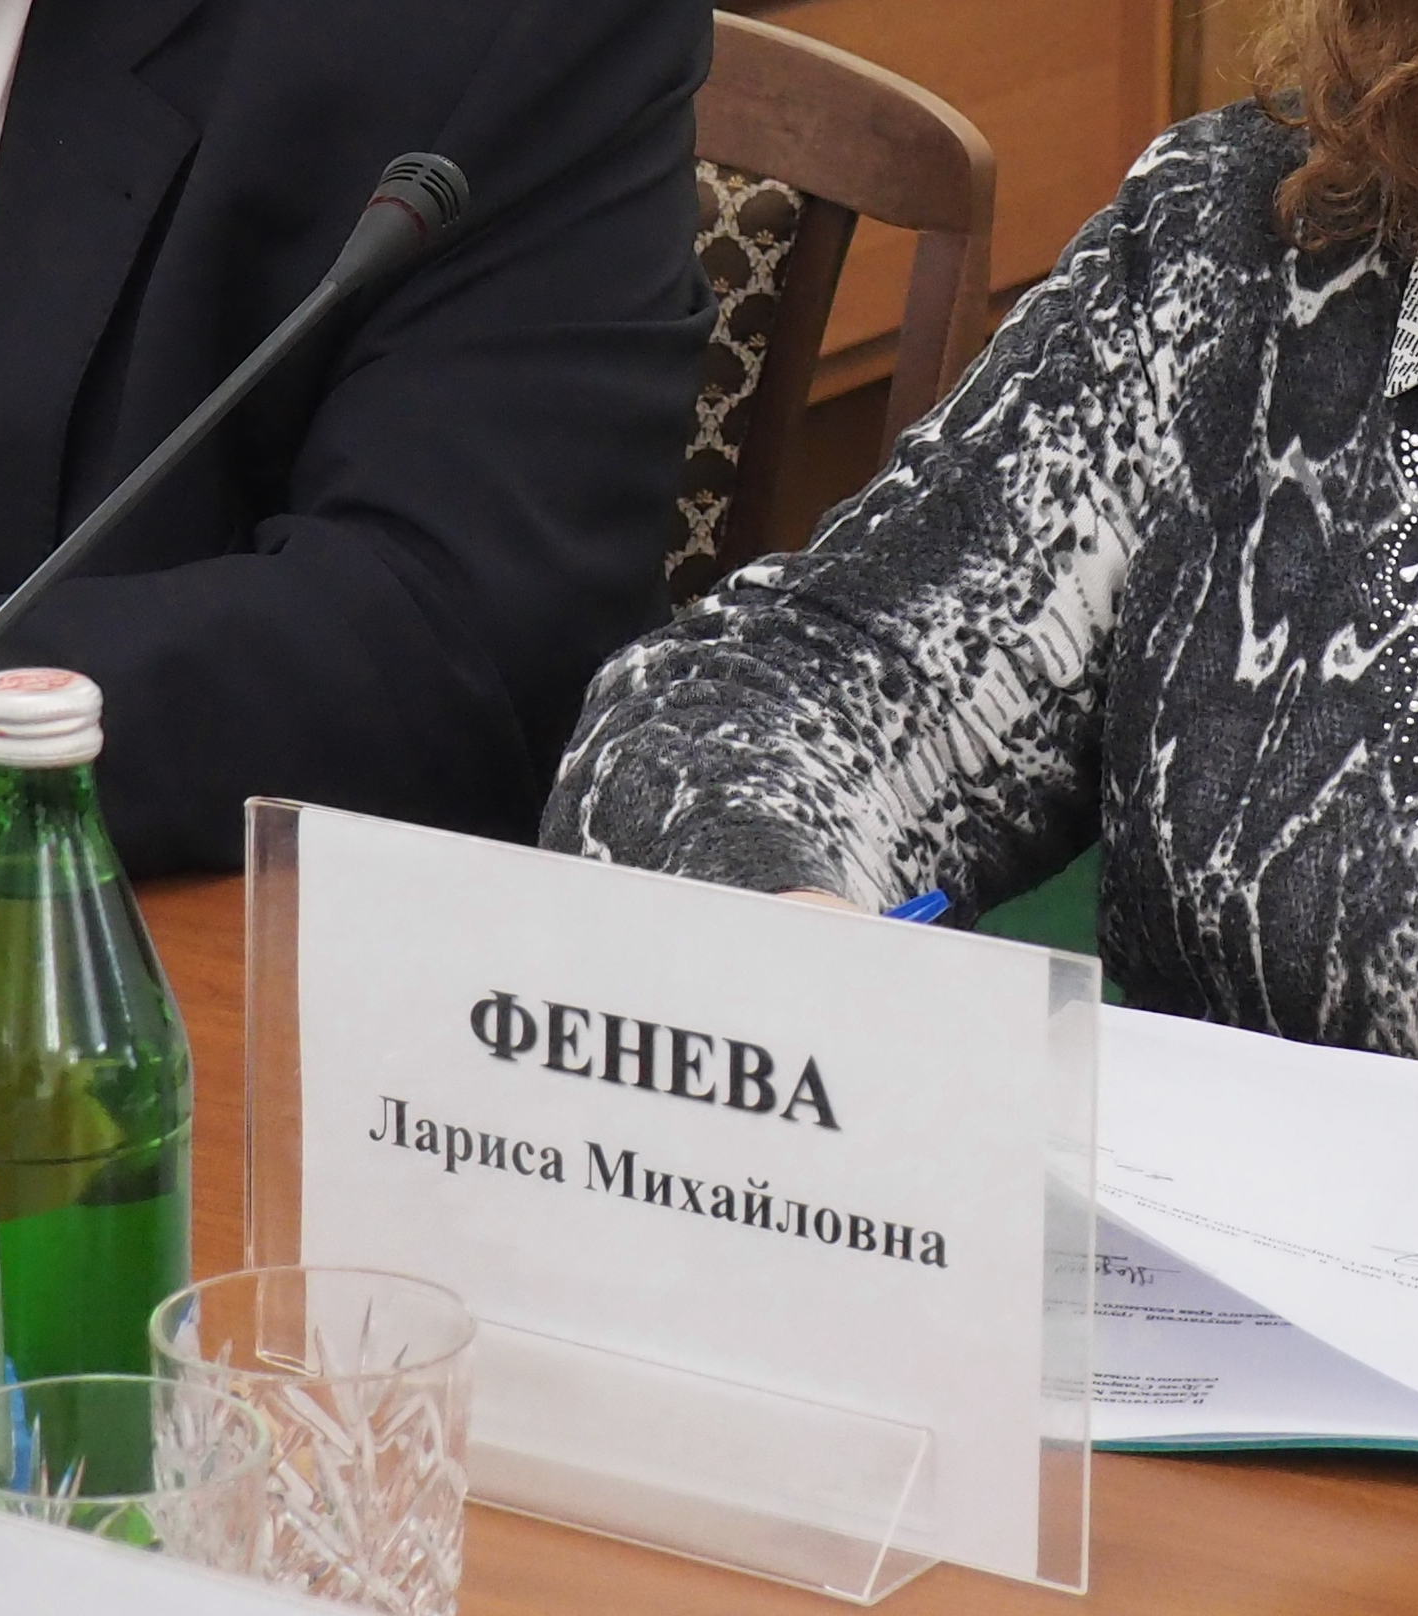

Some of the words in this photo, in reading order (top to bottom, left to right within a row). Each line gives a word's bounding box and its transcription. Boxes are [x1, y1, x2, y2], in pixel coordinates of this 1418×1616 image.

[469, 988, 843, 1133] ФЕНЕВА
[368, 1095, 565, 1184] Лариса
[584, 1140, 949, 1269] Михайловна
